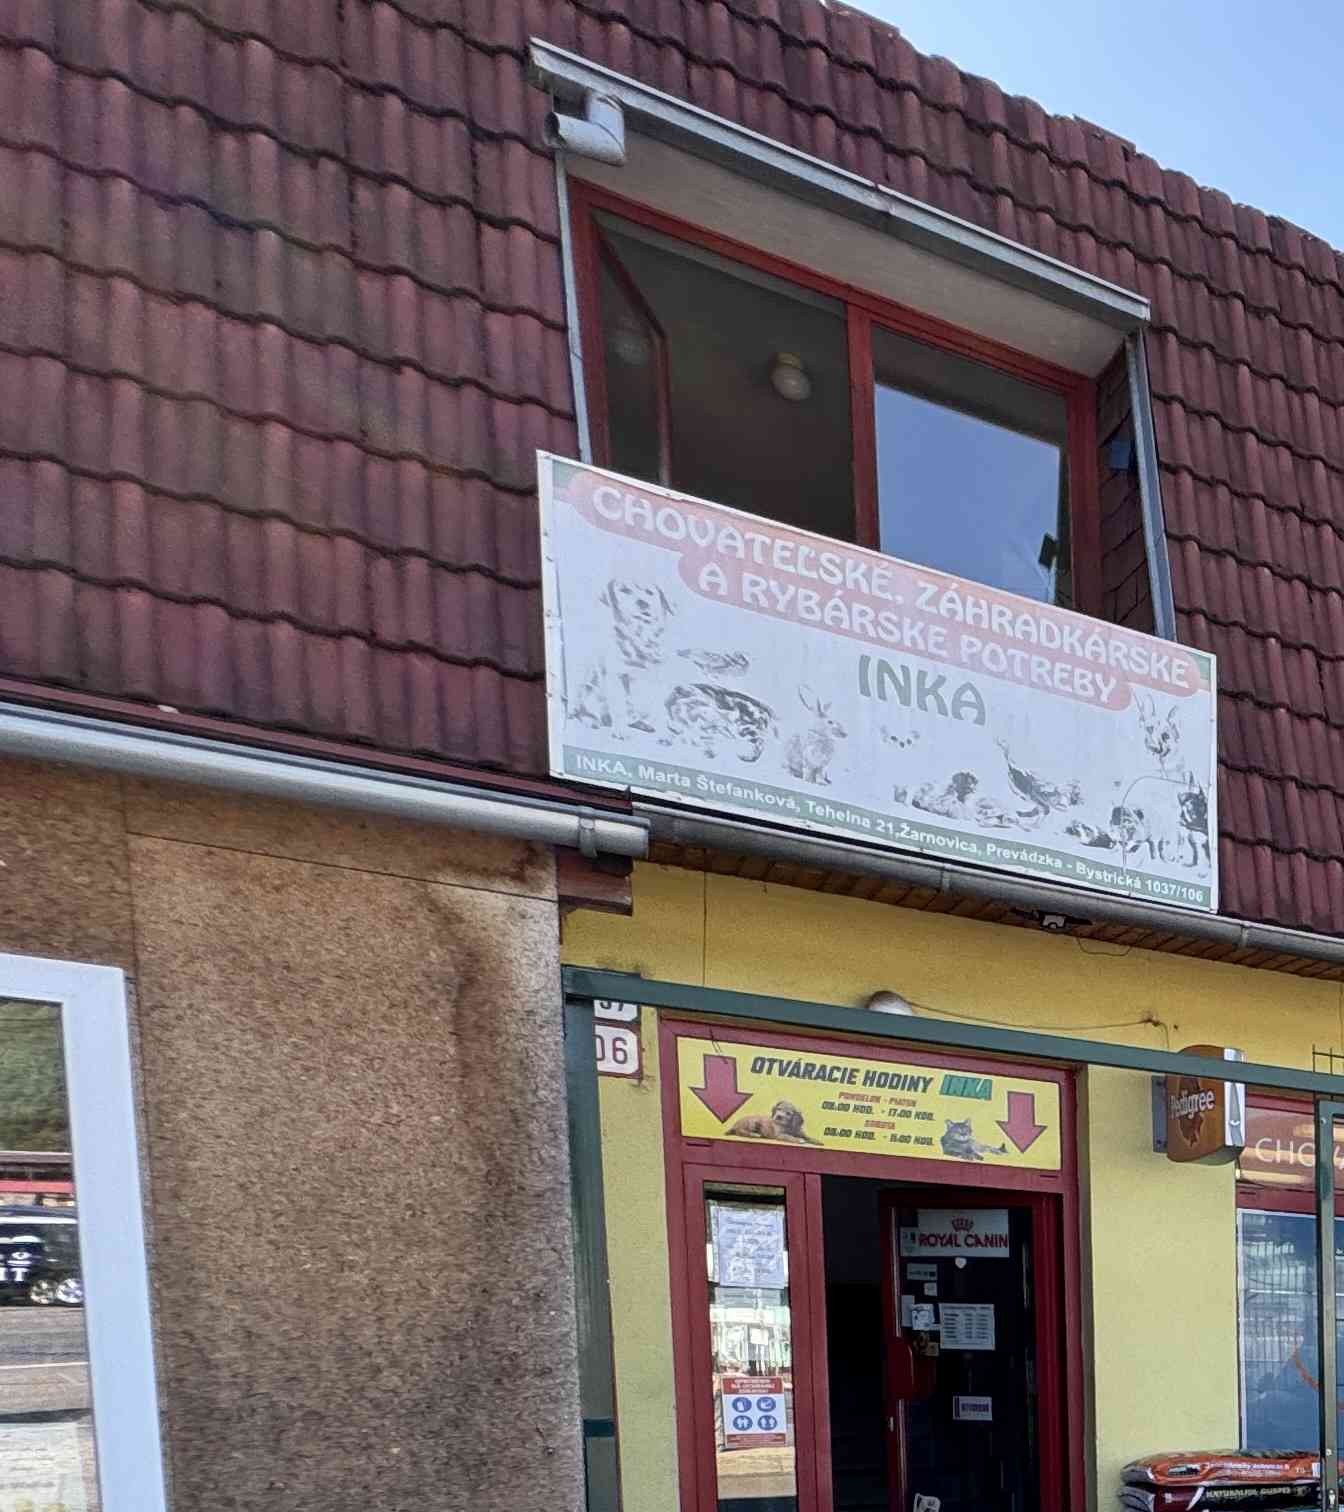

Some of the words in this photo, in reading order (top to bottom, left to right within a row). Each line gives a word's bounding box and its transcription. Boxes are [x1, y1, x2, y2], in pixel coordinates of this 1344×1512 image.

[699, 561, 728, 596] A
[742, 571, 948, 656] RYBÁRSKE
[960, 634, 1117, 703] POTREBY
[915, 580, 1190, 689] ZÁHRADKÁRSKE
[858, 653, 987, 727] INKA
[638, 764, 691, 788] Marta
[696, 774, 801, 813] Štefanková,
[806, 800, 871, 829] Tehelna
[986, 842, 1063, 869] Prevádzka
[1076, 861, 1142, 889] Bystrická
[1145, 878, 1204, 903] 1037/106
[751, 1055, 861, 1086] OTVÁRACIE
[862, 1069, 934, 1094] HODINY
[939, 1073, 993, 1102] INKA
[1170, 1089, 1216, 1119] Pedigree
[917, 1232, 962, 1248] ROYAL
[963, 1233, 1009, 1249] CANIN
